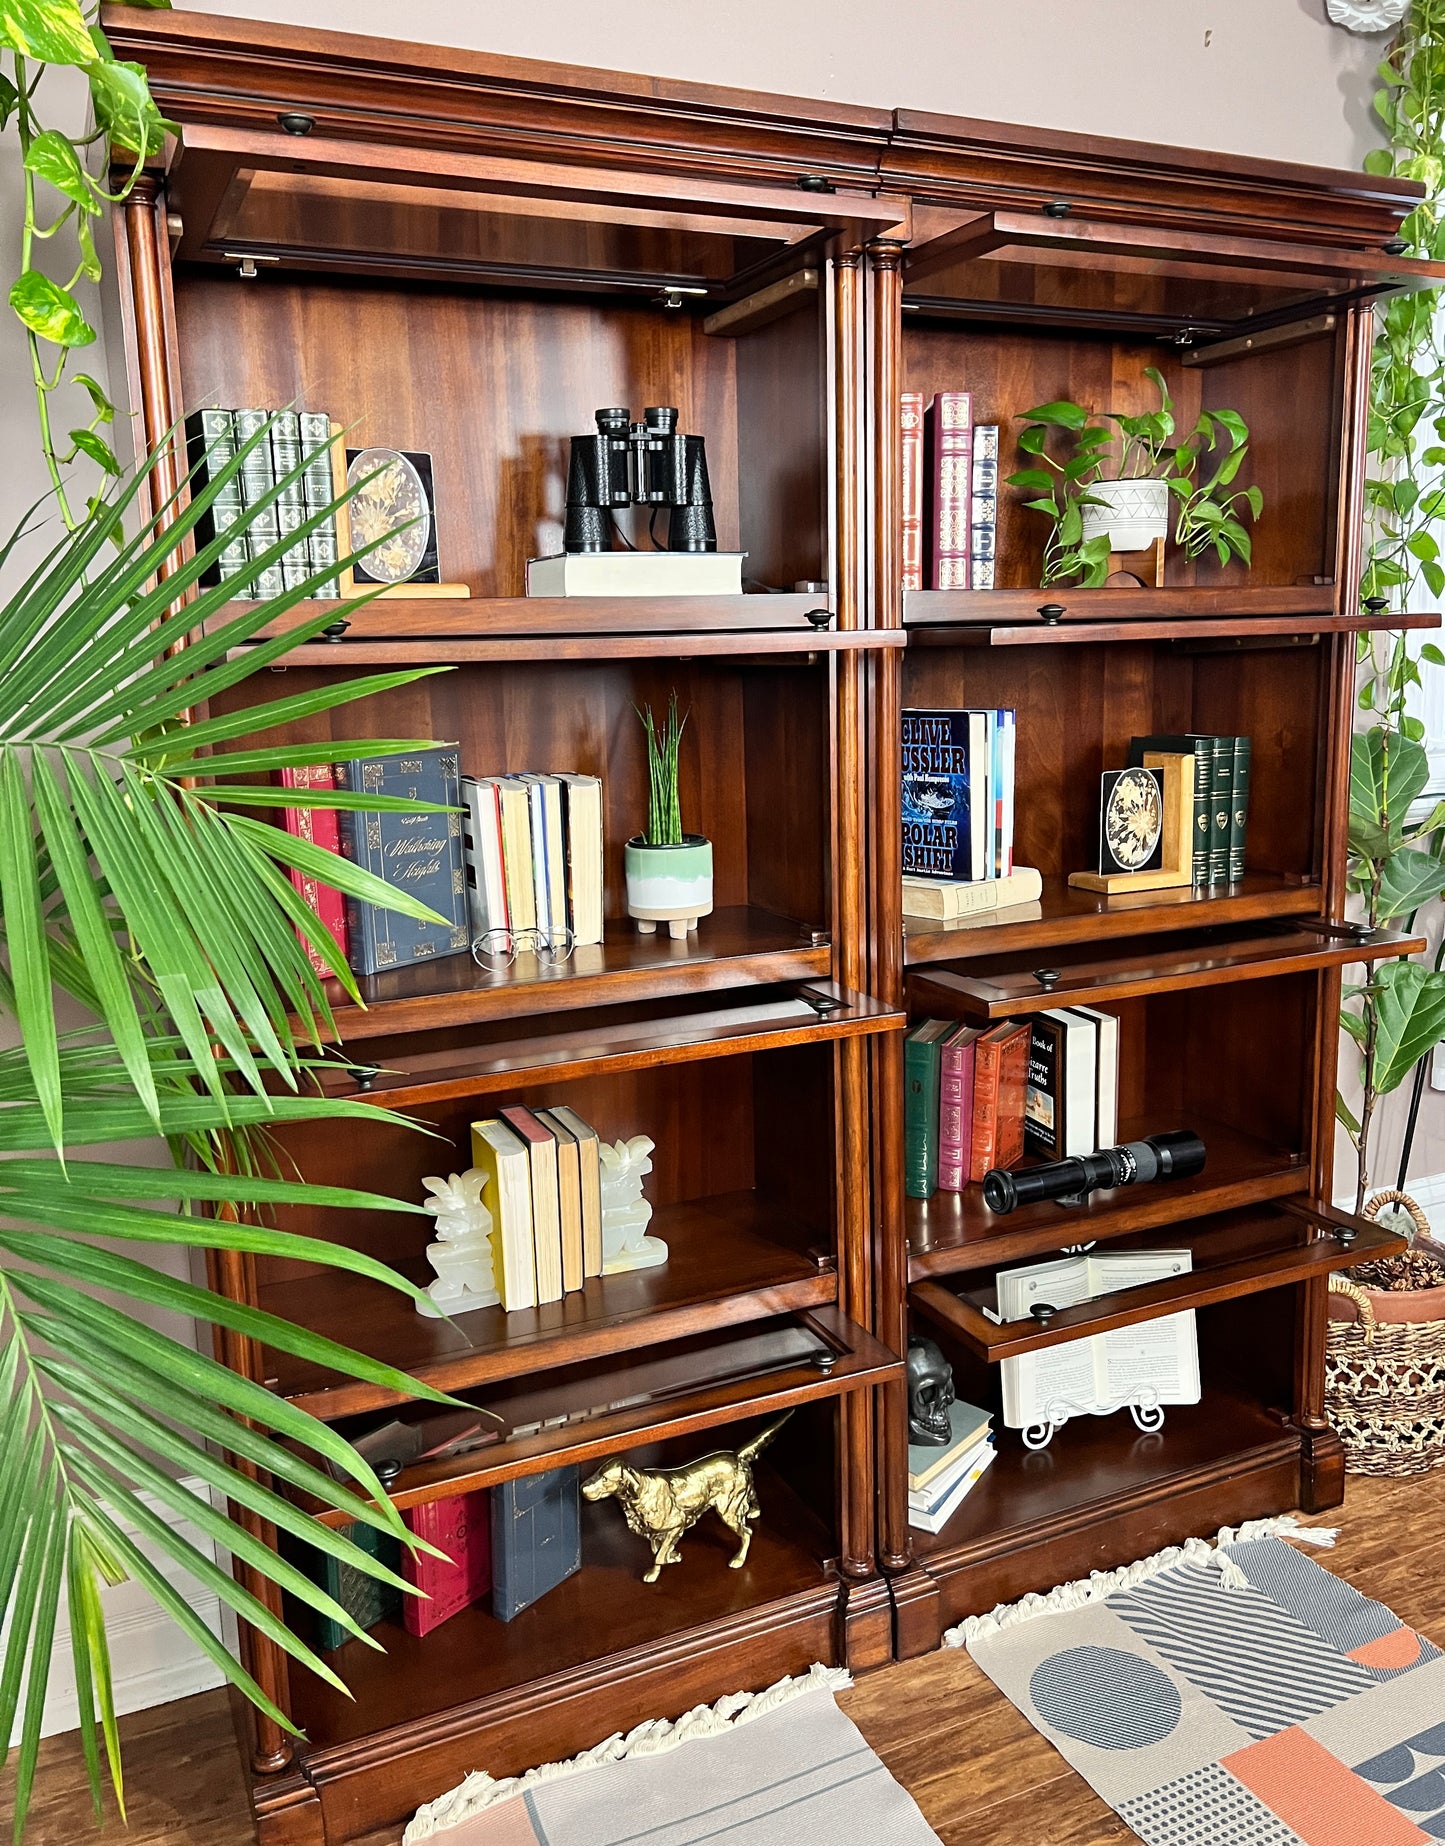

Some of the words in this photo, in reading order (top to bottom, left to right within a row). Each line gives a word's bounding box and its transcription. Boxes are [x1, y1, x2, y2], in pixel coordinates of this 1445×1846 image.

[901, 718, 951, 746] CLIVE
[901, 745, 965, 774] USSLER
[901, 822, 958, 849] POLAR
[903, 844, 954, 871] SHIFT
[393, 859, 441, 882] Heights
[1032, 1036, 1046, 1050] Book
[1047, 1043, 1053, 1053] of
[1028, 1067, 1047, 1086] Truths
[1029, 1056, 1048, 1074] izarre
